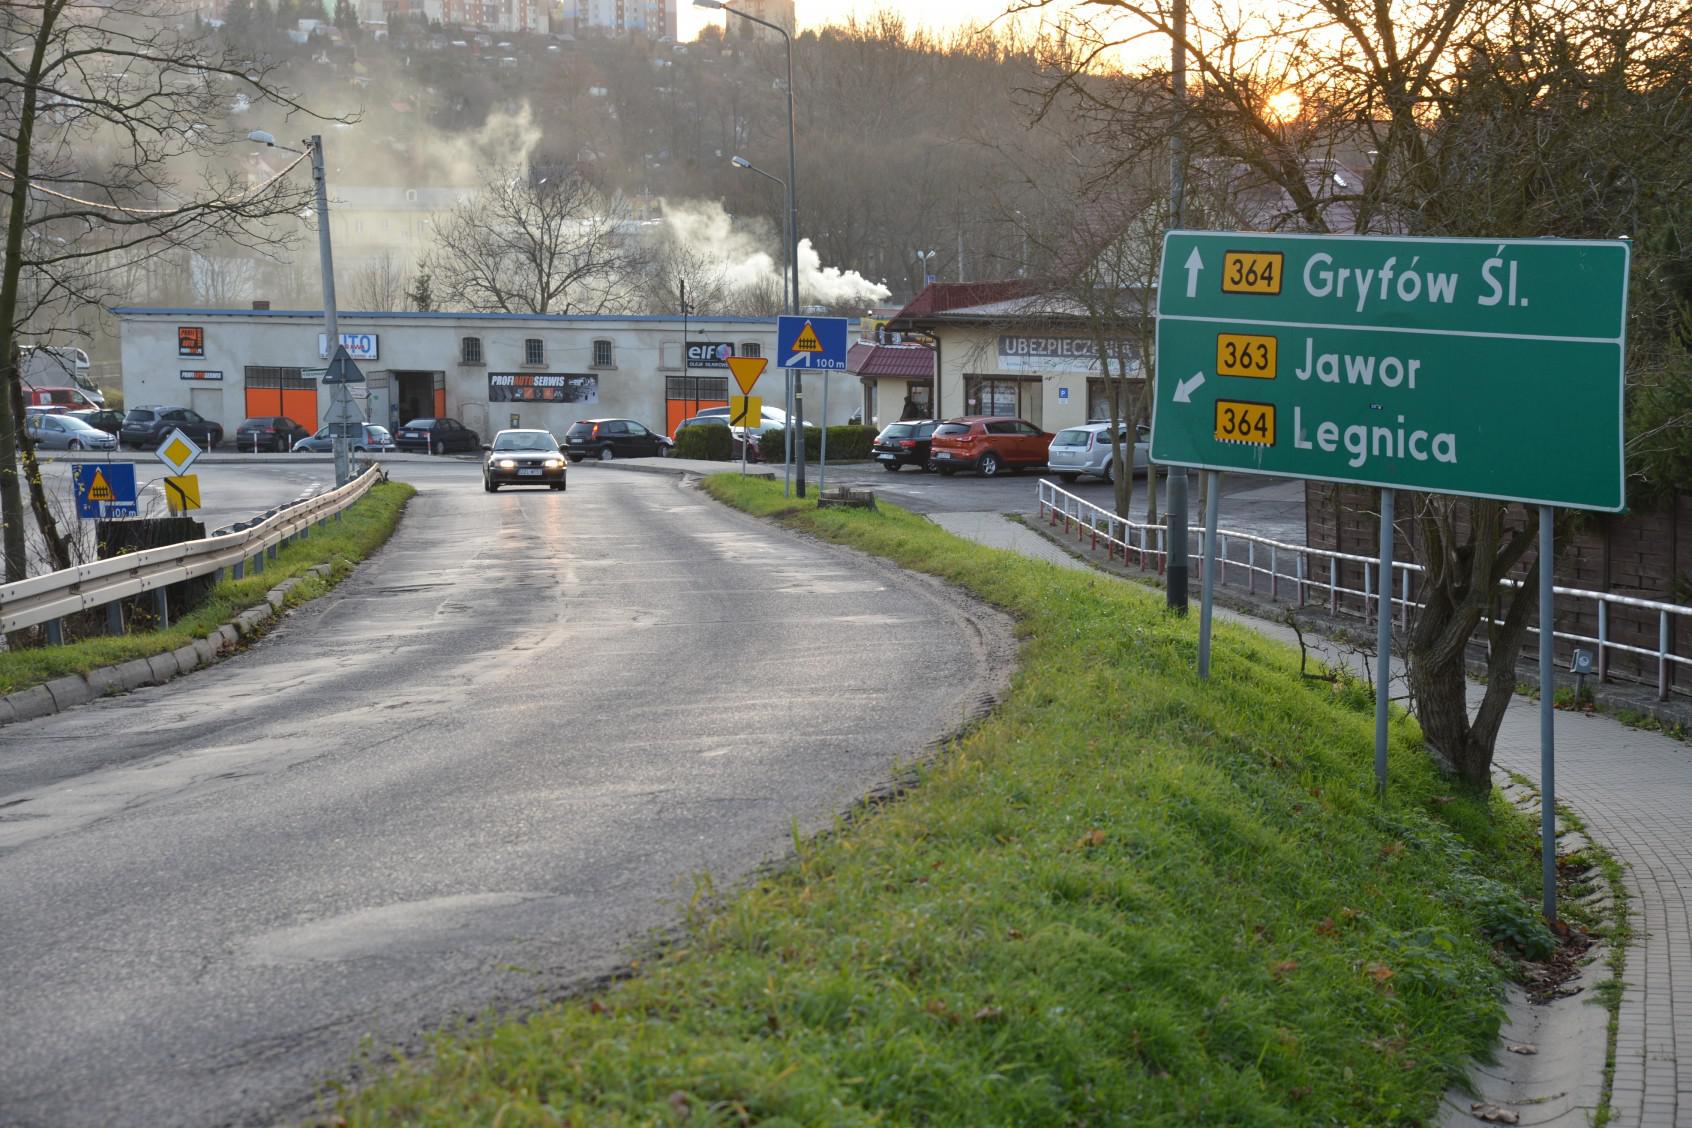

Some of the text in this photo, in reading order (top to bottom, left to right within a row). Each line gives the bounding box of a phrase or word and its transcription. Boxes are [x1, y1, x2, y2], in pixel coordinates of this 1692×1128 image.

[1230, 258, 1274, 288] 364
[1303, 244, 1528, 313] Gryfów Śl.
[688, 345, 716, 359] elf
[816, 358, 835, 368] 100
[1224, 341, 1269, 371] 363
[1295, 337, 1421, 389] Jawor
[1222, 407, 1268, 439] 364
[1294, 406, 1457, 468] Legnica
